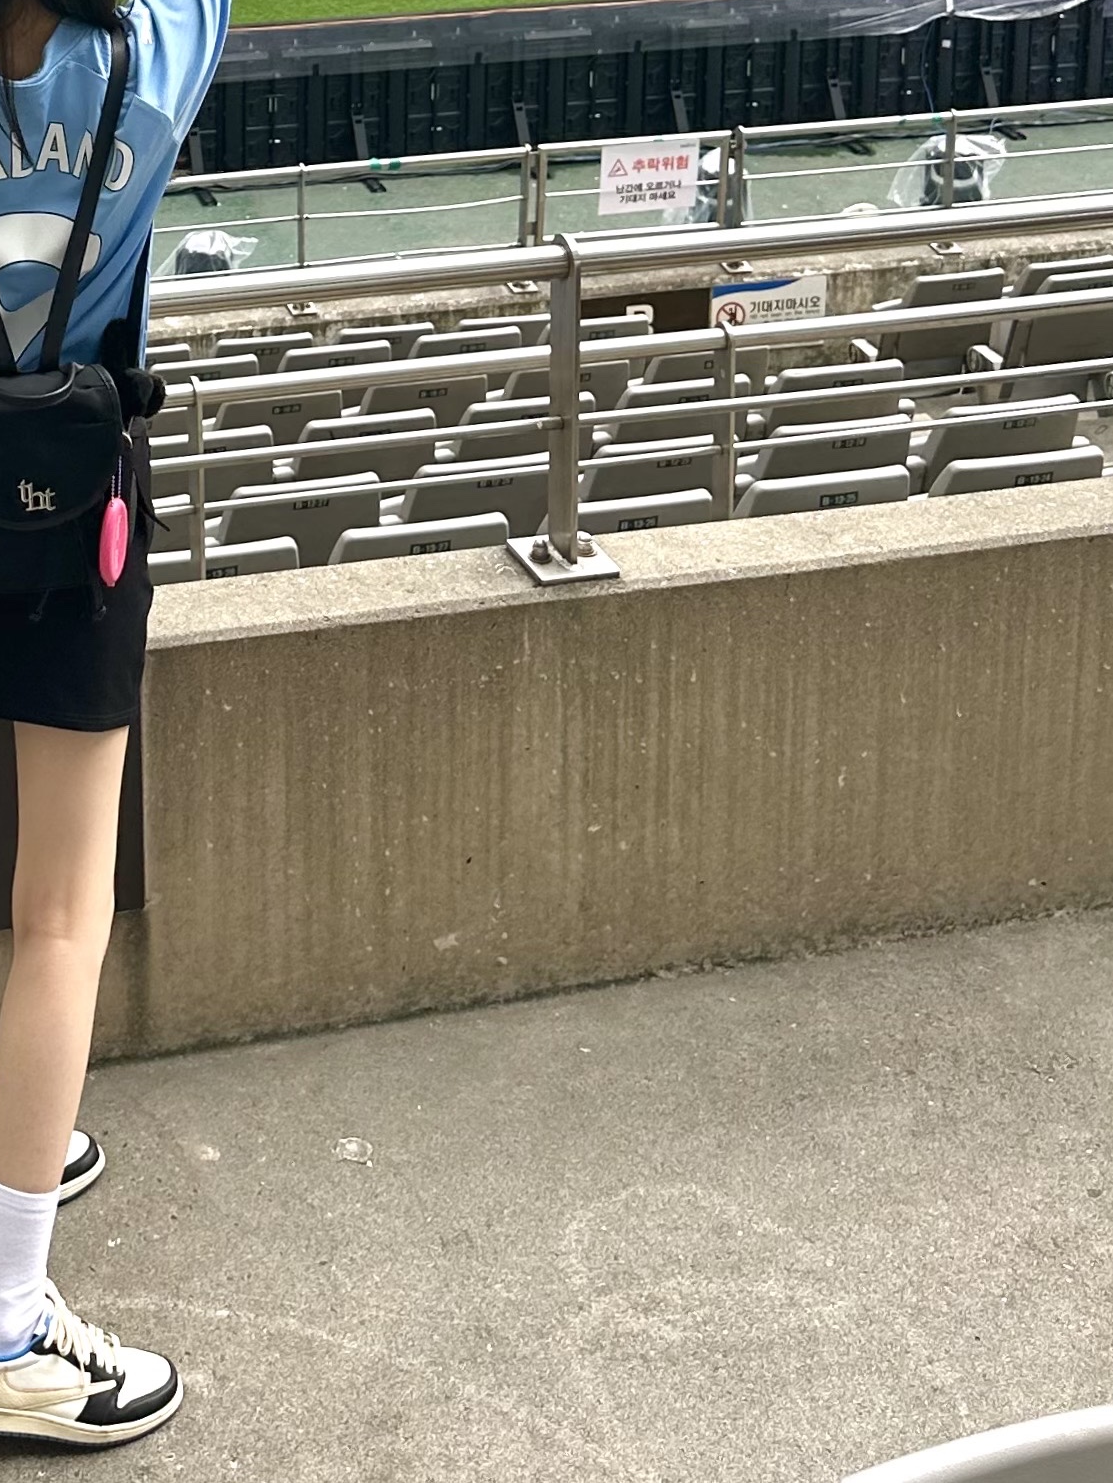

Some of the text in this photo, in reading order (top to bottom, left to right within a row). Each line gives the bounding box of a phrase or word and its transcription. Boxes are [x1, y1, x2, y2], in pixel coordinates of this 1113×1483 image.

[632, 155, 689, 173] 추락위험
[615, 179, 682, 195] 난간에 오르거나
[619, 191, 676, 204] 기대지 마세요
[750, 296, 820, 313] 기대지마시오
